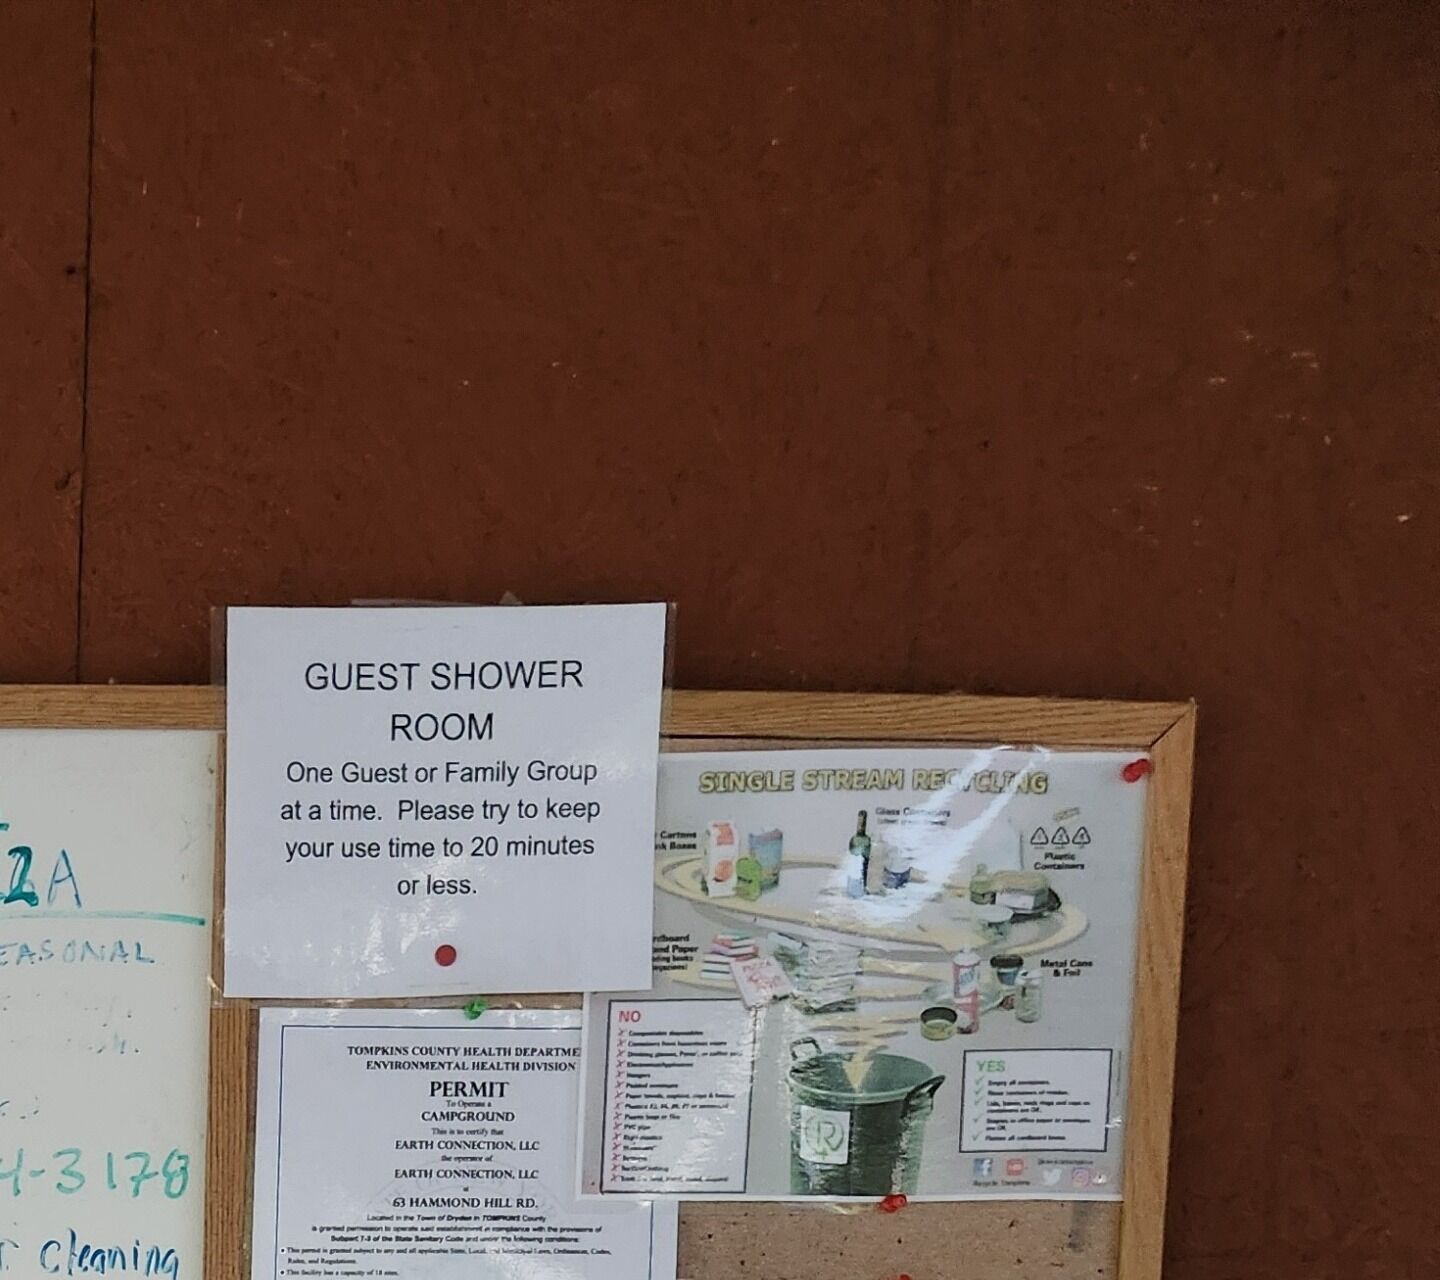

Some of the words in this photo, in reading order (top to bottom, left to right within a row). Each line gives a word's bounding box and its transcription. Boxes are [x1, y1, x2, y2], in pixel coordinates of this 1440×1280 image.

[305, 662, 420, 691] GUEST
[431, 659, 584, 690] SHOWER
[390, 712, 494, 741] ROOM
[286, 761, 333, 783] One
[341, 761, 408, 783] Guest
[415, 764, 438, 782] or
[445, 760, 519, 787] Family
[527, 759, 598, 786] Group
[699, 771, 794, 793] SINGLE
[801, 770, 904, 792] STREAM
[280, 800, 302, 821] at
[308, 805, 322, 821] a
[329, 800, 383, 821] time.
[398, 800, 475, 820] Please
[482, 800, 510, 825] try
[517, 799, 539, 819] to
[546, 797, 601, 823] keep
[285, 839, 335, 862] your
[341, 841, 381, 858] use
[388, 838, 435, 857] time
[443, 838, 464, 857] to
[471, 836, 499, 856] 20
[506, 835, 595, 855] minutes
[1033, 861, 1085, 871] Containers
[397, 877, 420, 895] or
[426, 875, 477, 894] less.
[618, 1010, 641, 1023] NO
[347, 1047, 409, 1056] TOMPKINS
[411, 1047, 460, 1056] COUNTY
[463, 1047, 511, 1056] HEALTH
[514, 1047, 580, 1057] DEPARTME
[366, 1061, 468, 1070] ENVIRONMENTAL
[472, 1062, 519, 1071] HEALTH
[523, 1062, 576, 1071] DIVISION
[977, 1060, 1006, 1073] YES
[429, 1081, 509, 1097] PERMIT
[421, 1112, 515, 1121] CAMPGROUND
[395, 1141, 433, 1150] EARTH
[437, 1141, 516, 1151] CONNECTION,
[519, 1141, 540, 1150] LLC
[395, 1169, 433, 1178] EARTH
[436, 1170, 515, 1180] CONNECTION,
[518, 1170, 539, 1179] LLC
[393, 1199, 405, 1207] 63
[410, 1198, 480, 1208] HAMMOND
[485, 1199, 512, 1208] HILL
[516, 1199, 538, 1208] RD.
